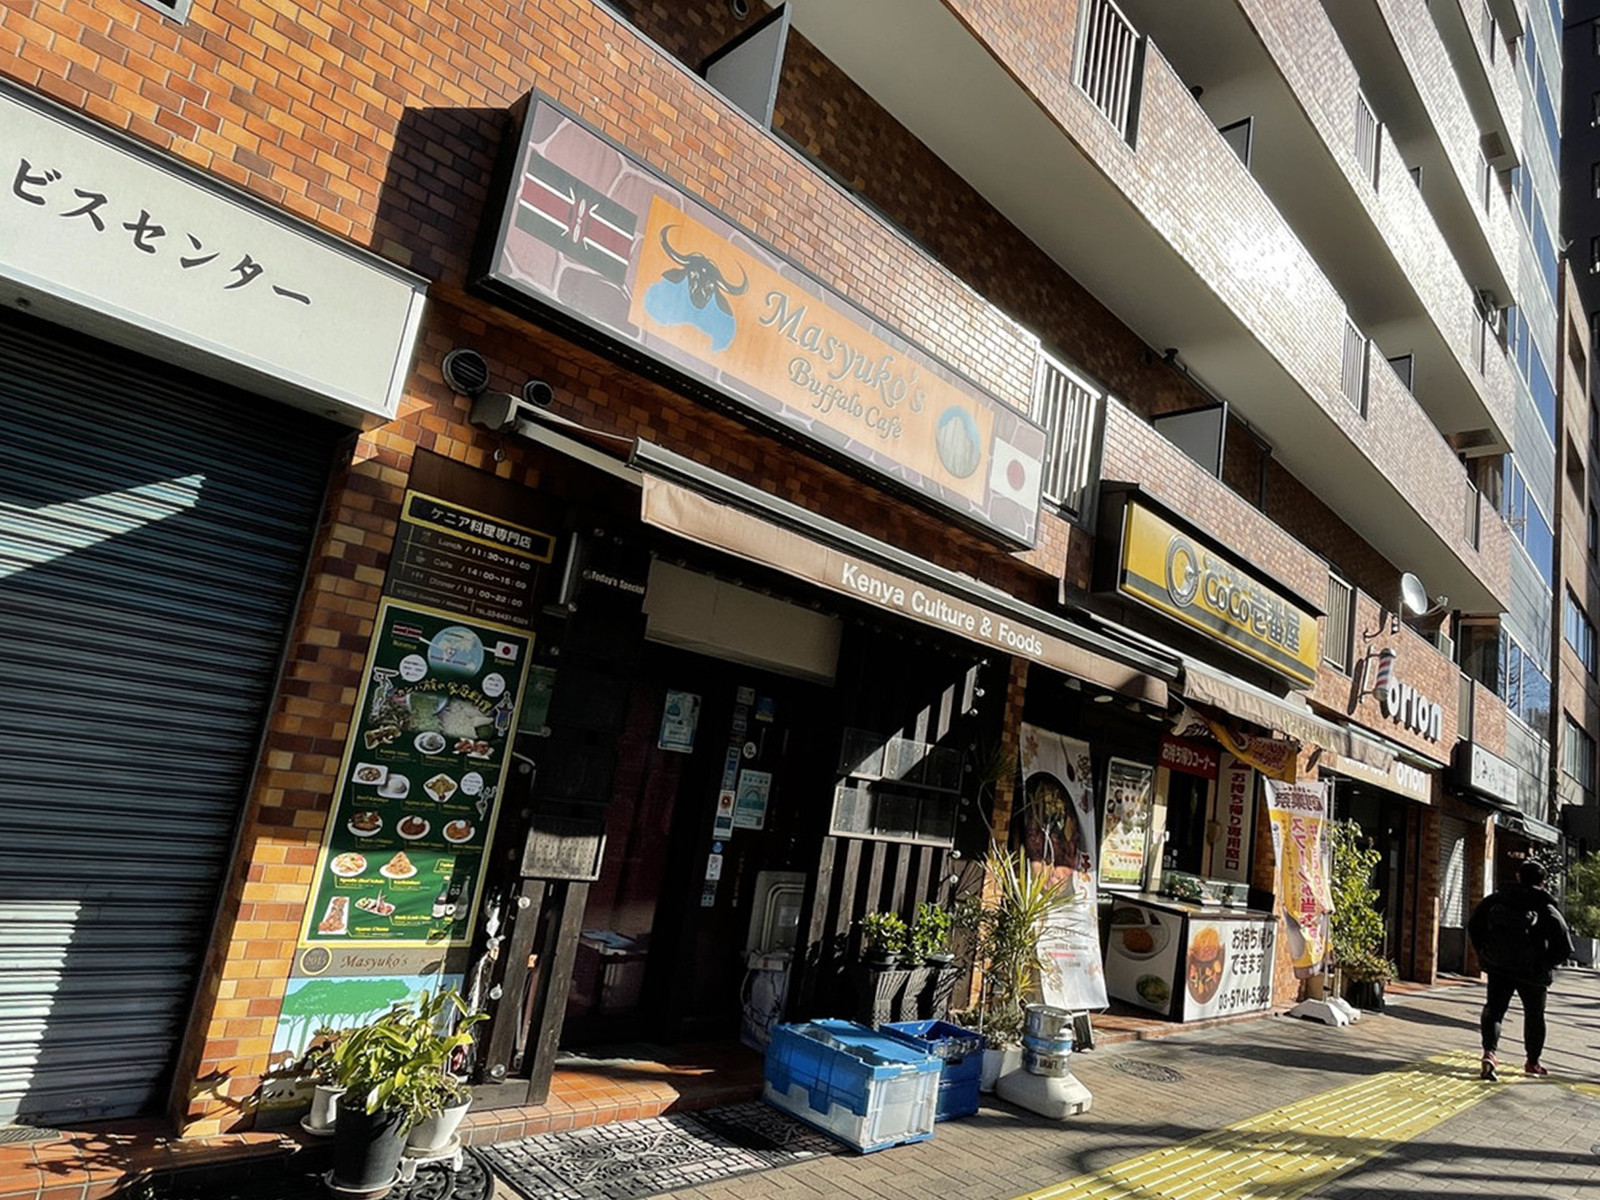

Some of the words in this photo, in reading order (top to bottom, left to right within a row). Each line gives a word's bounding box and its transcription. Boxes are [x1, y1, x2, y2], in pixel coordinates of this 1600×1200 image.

[13, 158, 312, 306] ビスセンター
[758, 290, 927, 413] Masyuko's
[788, 356, 865, 421] Buffalo
[430, 507, 532, 550] ケニア料理専門店
[841, 562, 904, 605] Kenya
[911, 590, 976, 631] Culture
[979, 617, 993, 638] &
[998, 621, 1044, 656] Foods
[1386, 677, 1441, 741] orion
[1396, 761, 1426, 795] orion
[340, 953, 408, 971] Masyuko's
[1230, 953, 1266, 975] できます
[1231, 927, 1275, 950] お持ち帰り
